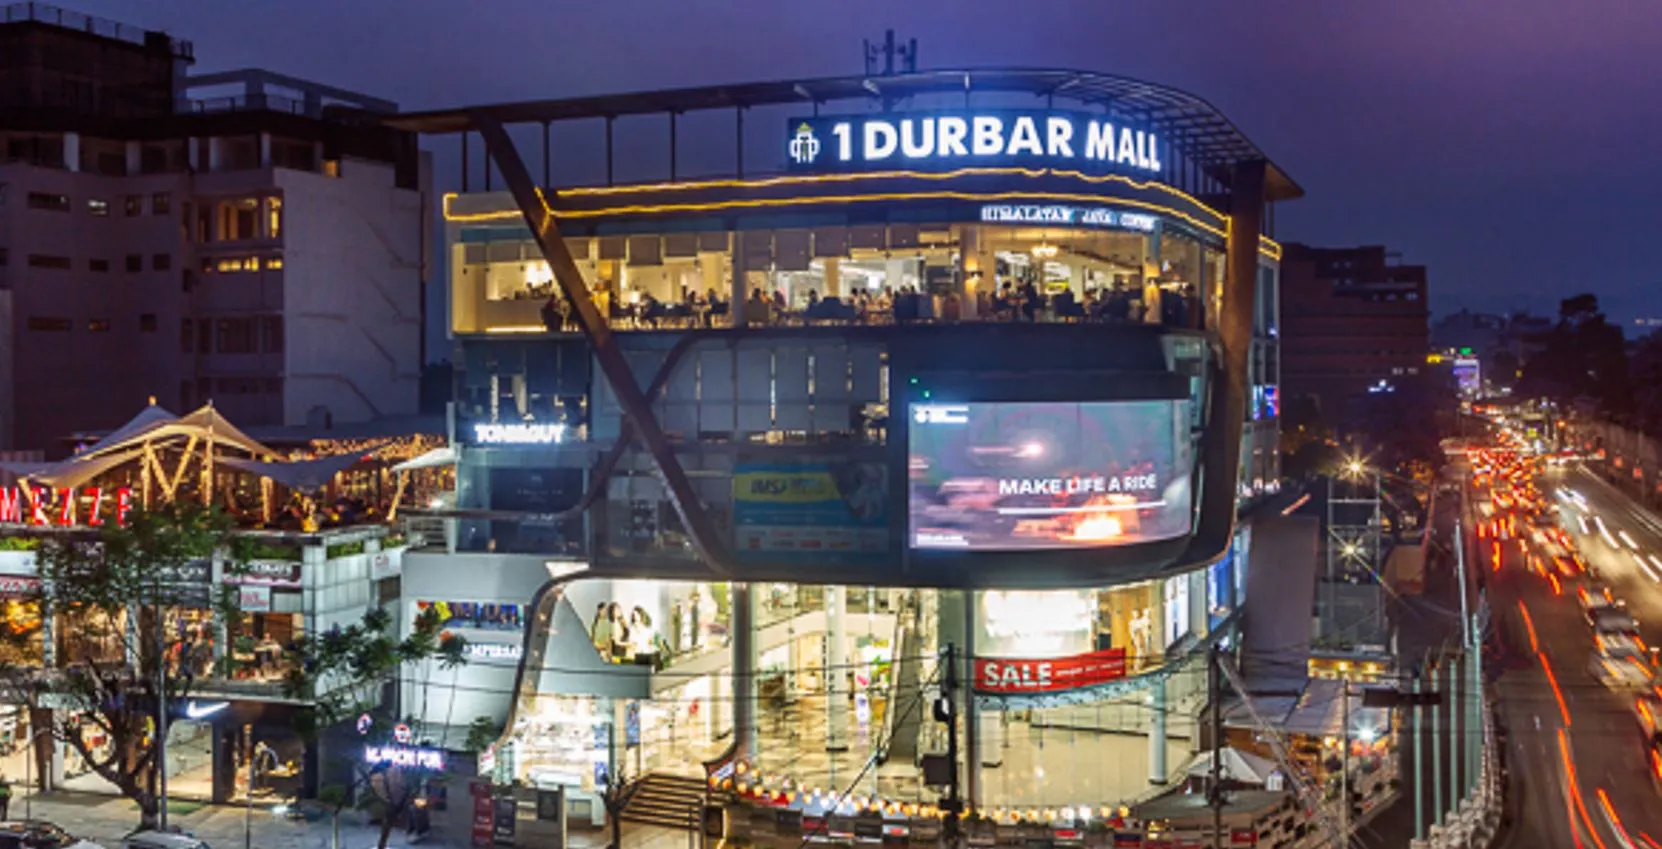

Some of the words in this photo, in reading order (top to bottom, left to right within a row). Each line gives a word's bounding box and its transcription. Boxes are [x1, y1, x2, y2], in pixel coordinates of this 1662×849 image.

[832, 121, 851, 161] 1
[863, 115, 1075, 161] DURBAR
[1084, 119, 1162, 173] MALL
[998, 478, 1063, 495] MAKE
[1065, 475, 1105, 494] LIFE
[1107, 476, 1121, 492] A
[1122, 473, 1157, 491] RIDE
[0, 485, 134, 529] MEZZE
[983, 662, 1053, 688] SALE
